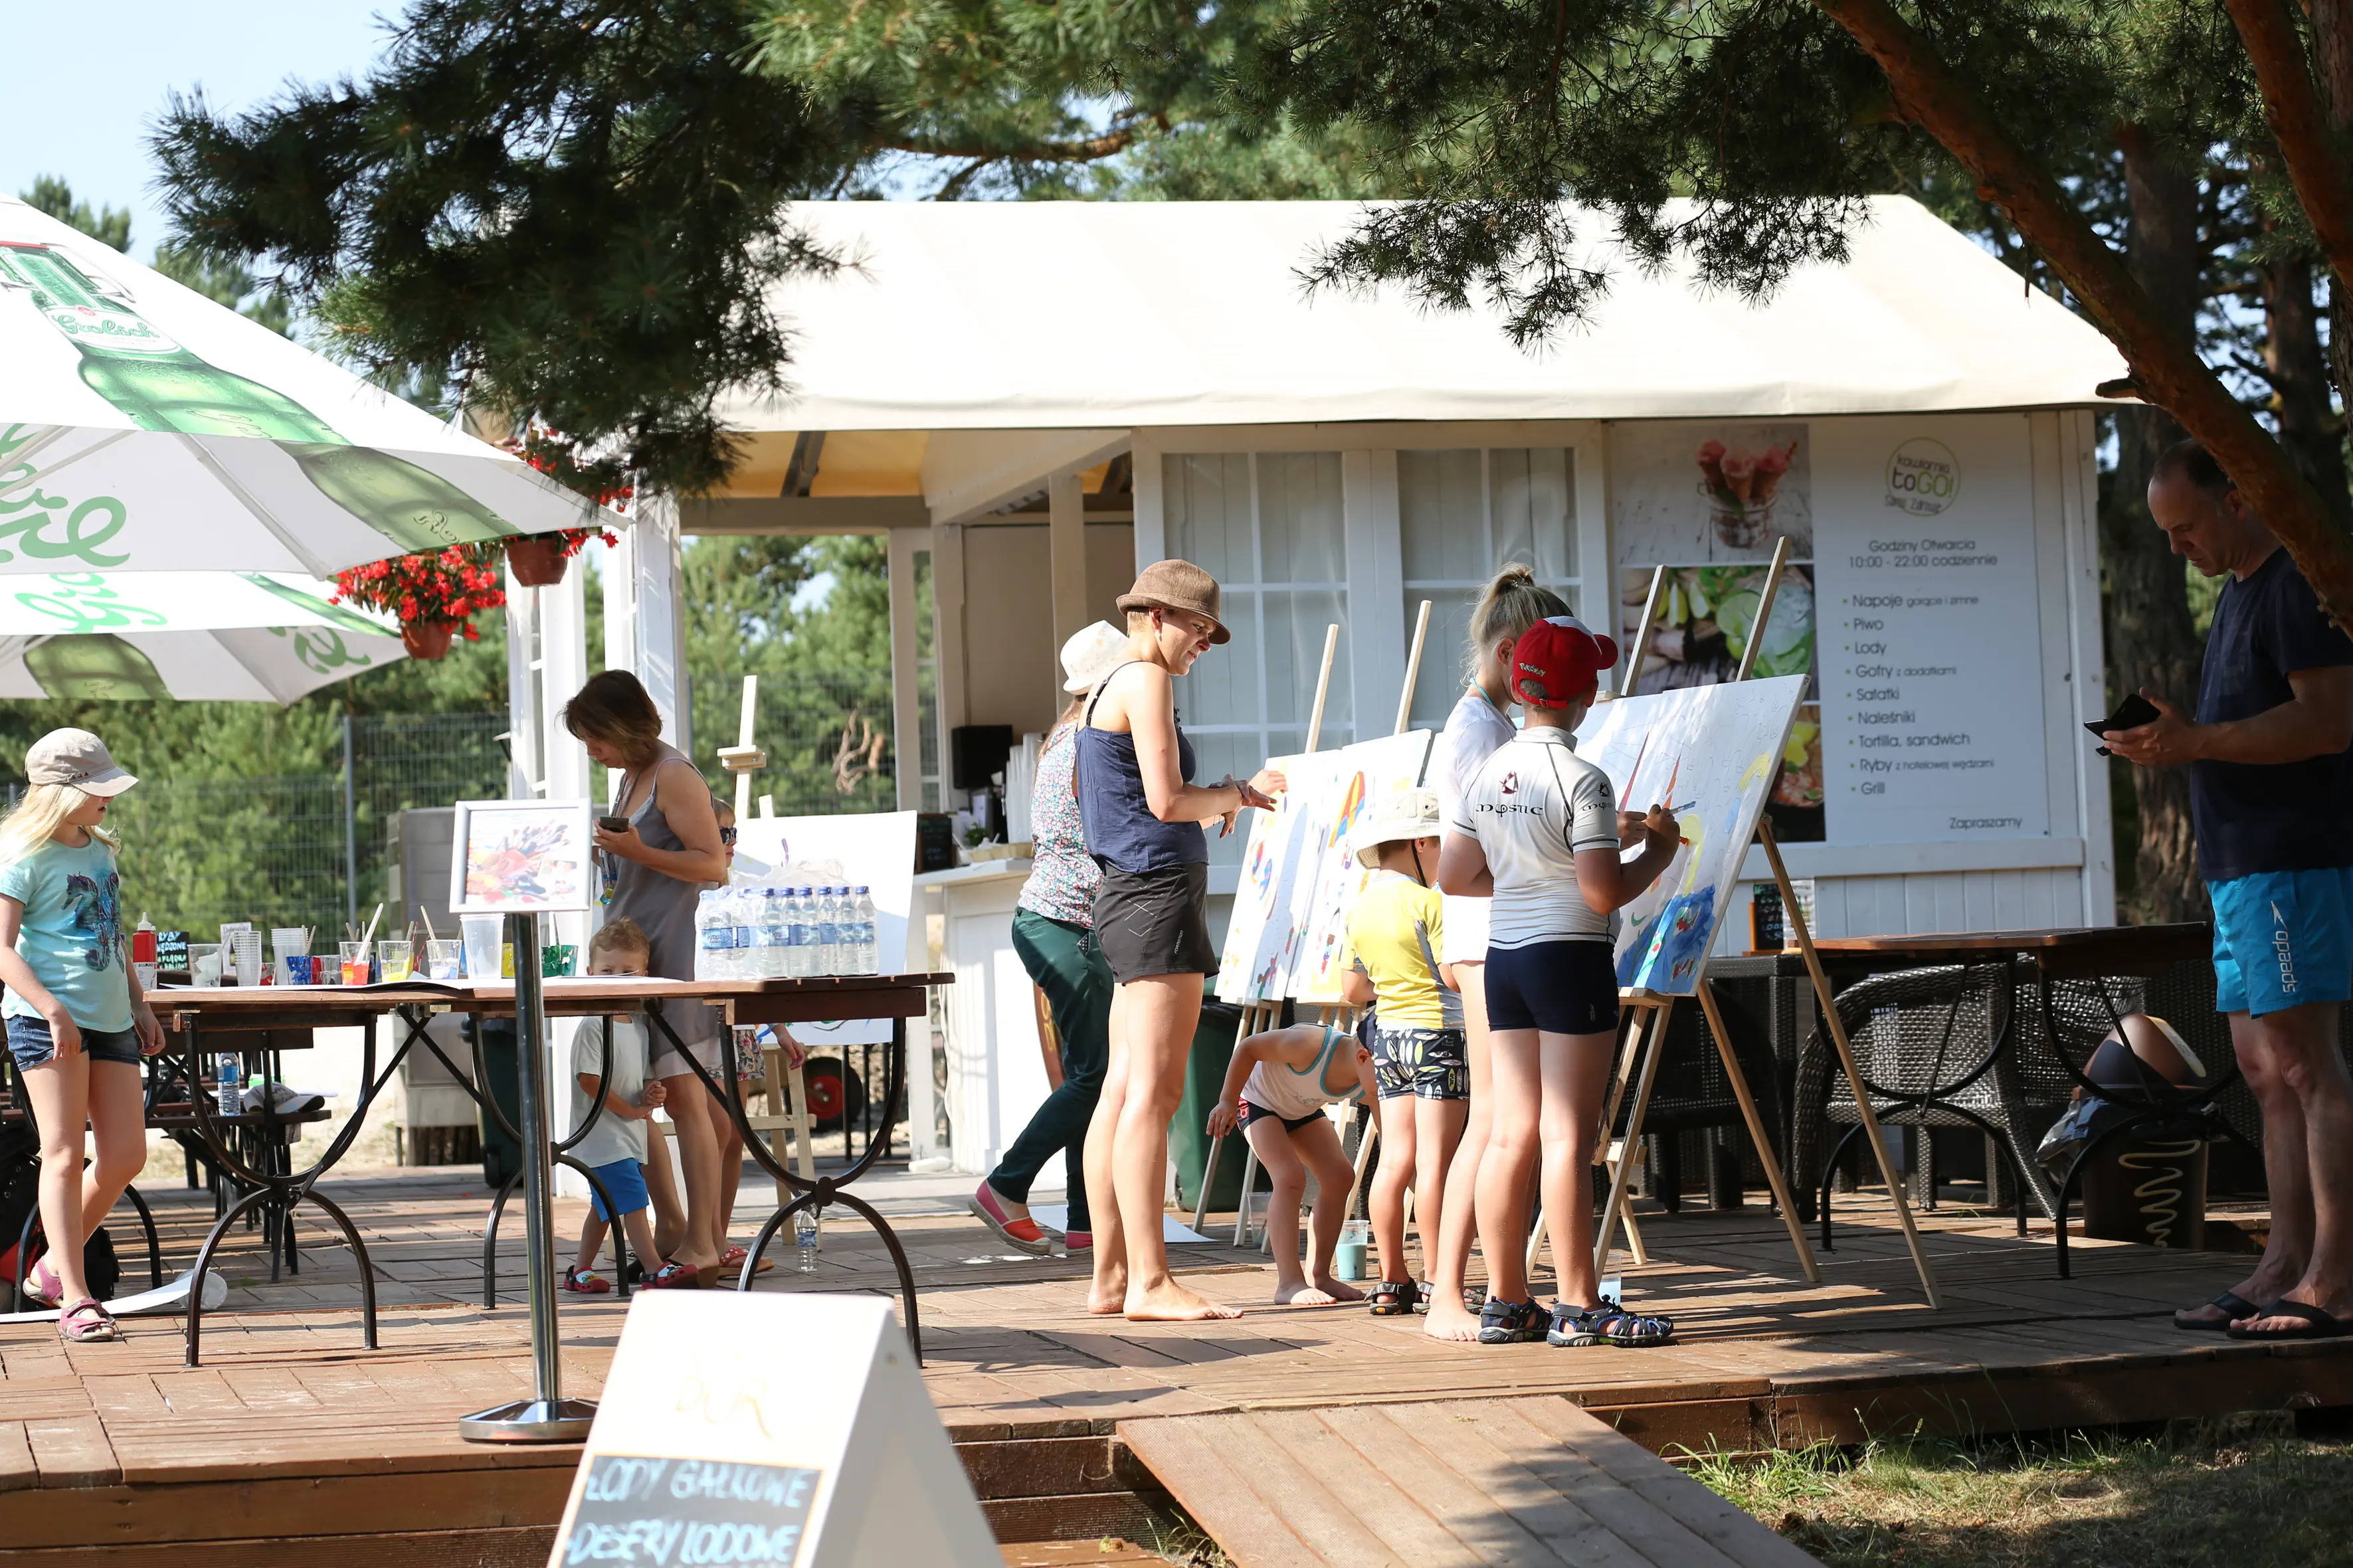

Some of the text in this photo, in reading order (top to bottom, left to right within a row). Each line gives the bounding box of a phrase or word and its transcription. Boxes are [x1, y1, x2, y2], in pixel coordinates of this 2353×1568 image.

[52, 315, 160, 339] Grolsch
[1869, 539, 1976, 553] Godziny Otwarcia
[1849, 556, 1883, 568] 10:00
[1895, 555, 1929, 567] 22:00
[1932, 554, 1998, 566] codziennie
[1853, 594, 1903, 609] Napoje
[1853, 617, 1884, 631] Piwo
[1855, 641, 1887, 656] Lody
[1856, 664, 1893, 679] Gofry
[1906, 733, 1970, 746] sandwich
[1859, 758, 1893, 773] Ryby
[1861, 782, 1885, 795] Grill
[1949, 816, 2023, 831] Zapraszamy
[2273, 930, 2298, 993] speedo
